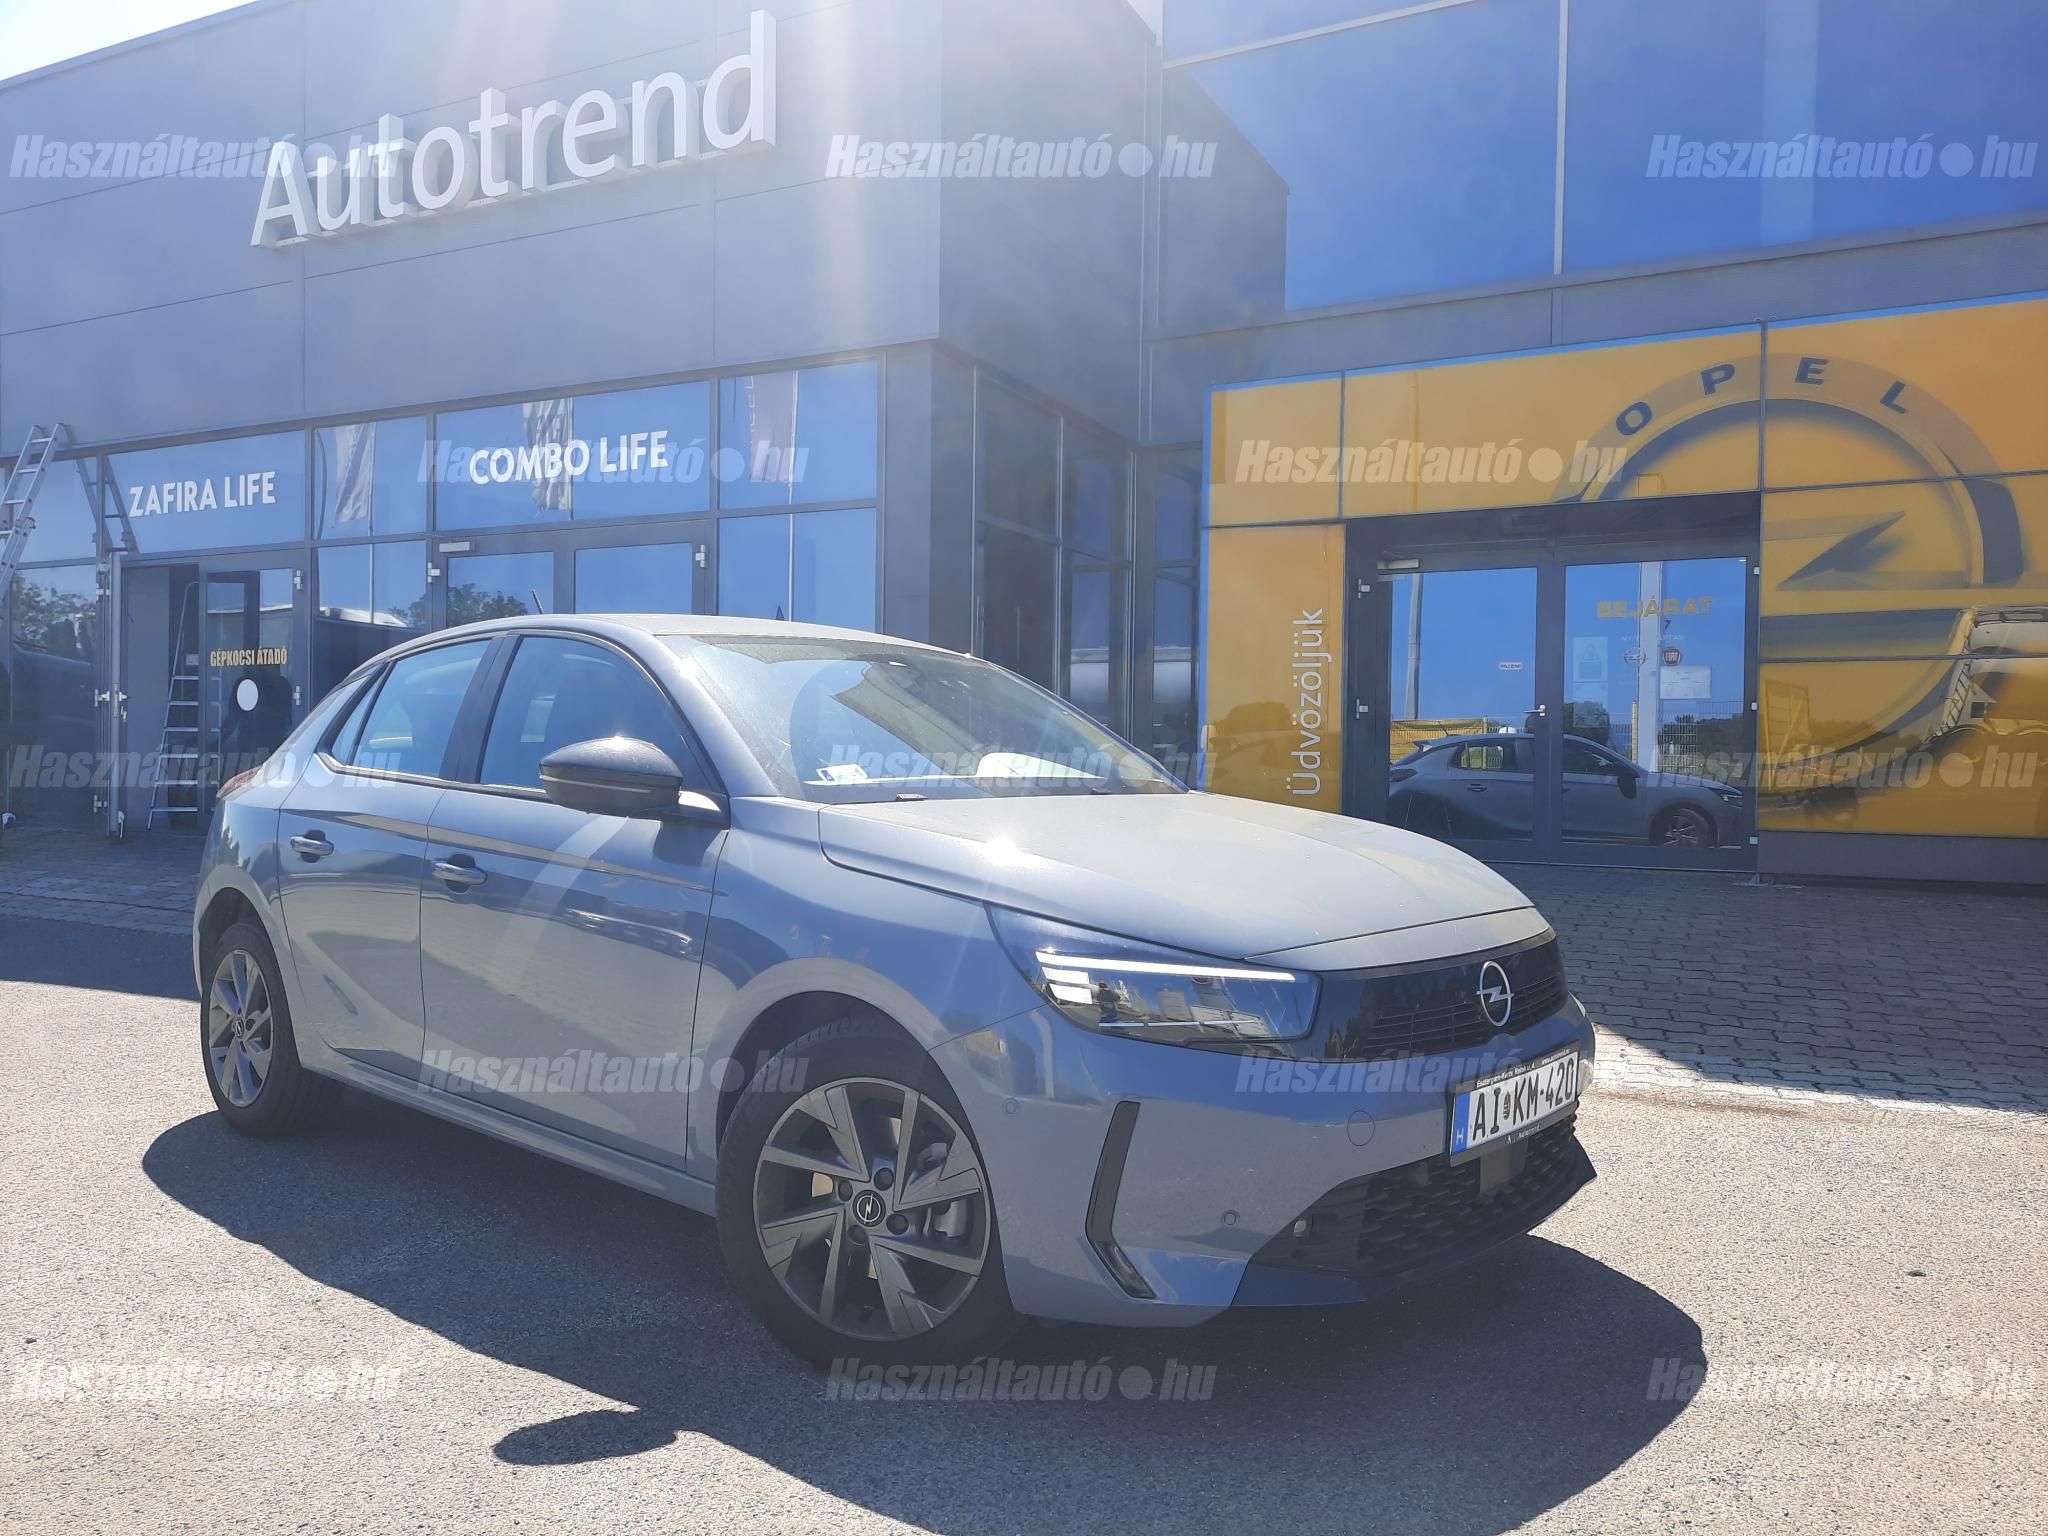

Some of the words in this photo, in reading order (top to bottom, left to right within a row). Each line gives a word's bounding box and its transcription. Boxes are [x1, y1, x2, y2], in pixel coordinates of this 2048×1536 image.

[251, 10, 777, 248] Autotrend
[1614, 356, 1910, 437] OPEL
[469, 439, 590, 485] COMBO
[599, 430, 669, 473] LIFE
[128, 476, 218, 517] ZAFIRA
[224, 471, 277, 508] LIFE
[1596, 595, 1713, 619] BEJÁRAT
[210, 648, 255, 667] GÉPKOCSI
[257, 645, 288, 665] ÁTADÓ
[1665, 651, 1678, 662] FIAT
[1285, 607, 1332, 796] Üdvözöljük
[1456, 1128, 1468, 1146] H
[1512, 1057, 1575, 1126] KM-420
